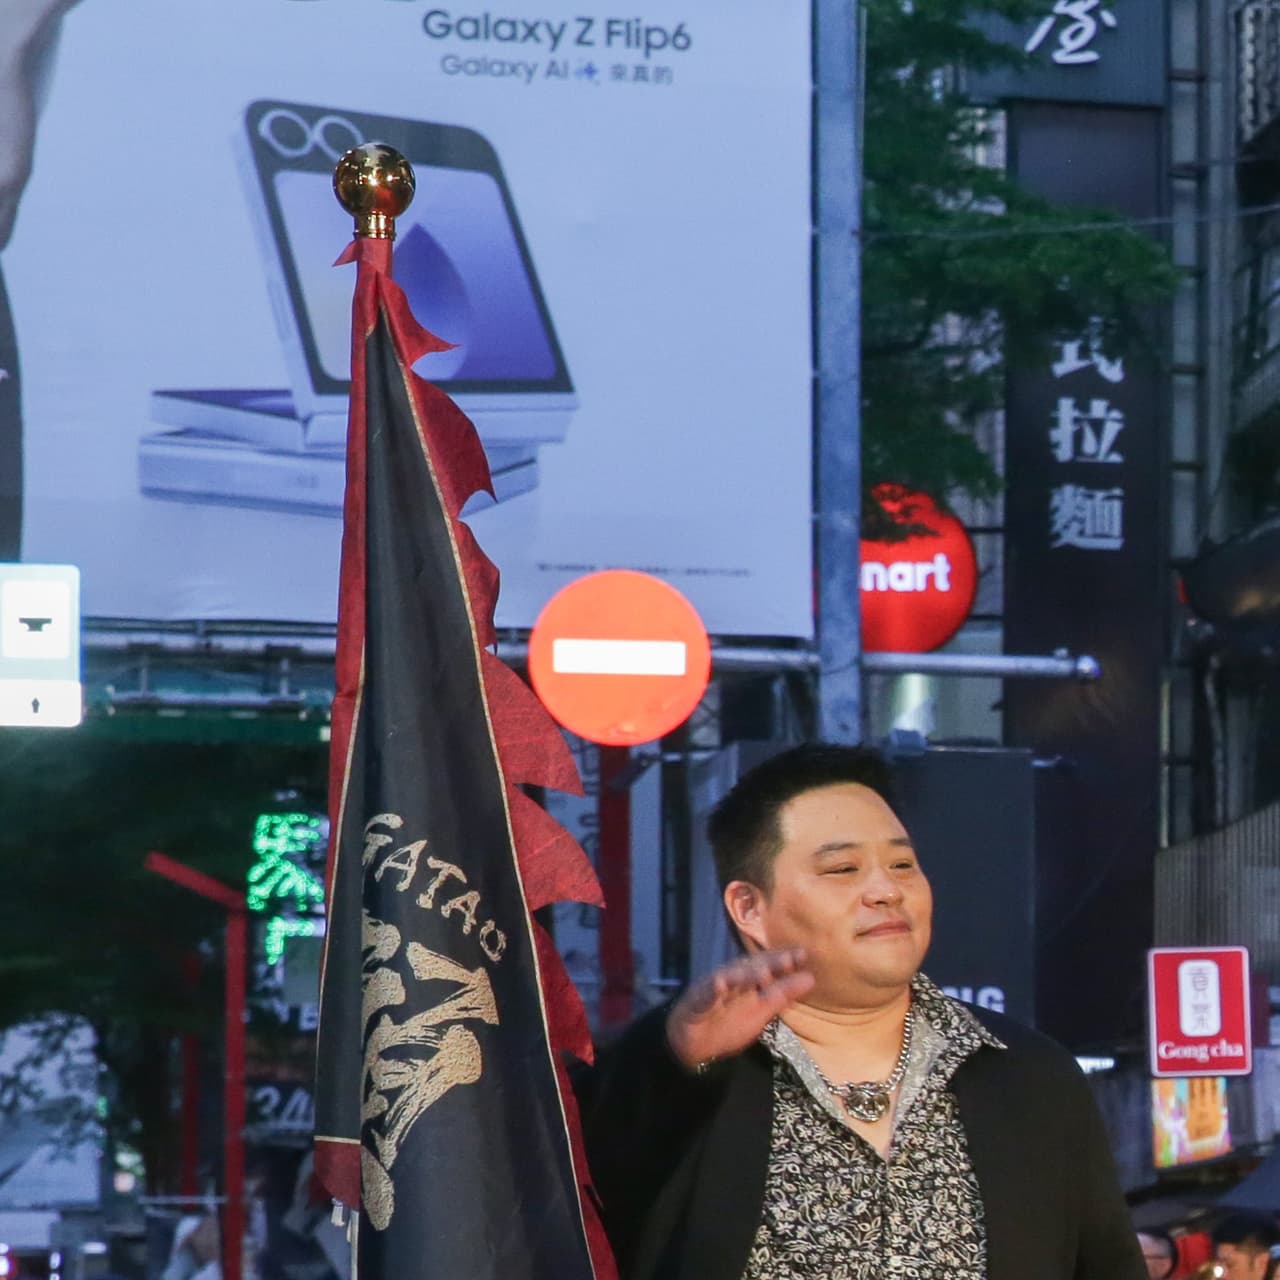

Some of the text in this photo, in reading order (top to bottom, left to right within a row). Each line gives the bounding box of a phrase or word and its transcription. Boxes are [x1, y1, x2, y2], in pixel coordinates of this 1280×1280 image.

[422, 10, 692, 59] Galaxy Z Flip6
[440, 54, 538, 84] Galaxy
[545, 60, 569, 79] AI
[1158, 1038, 1244, 1064] Gong cha
